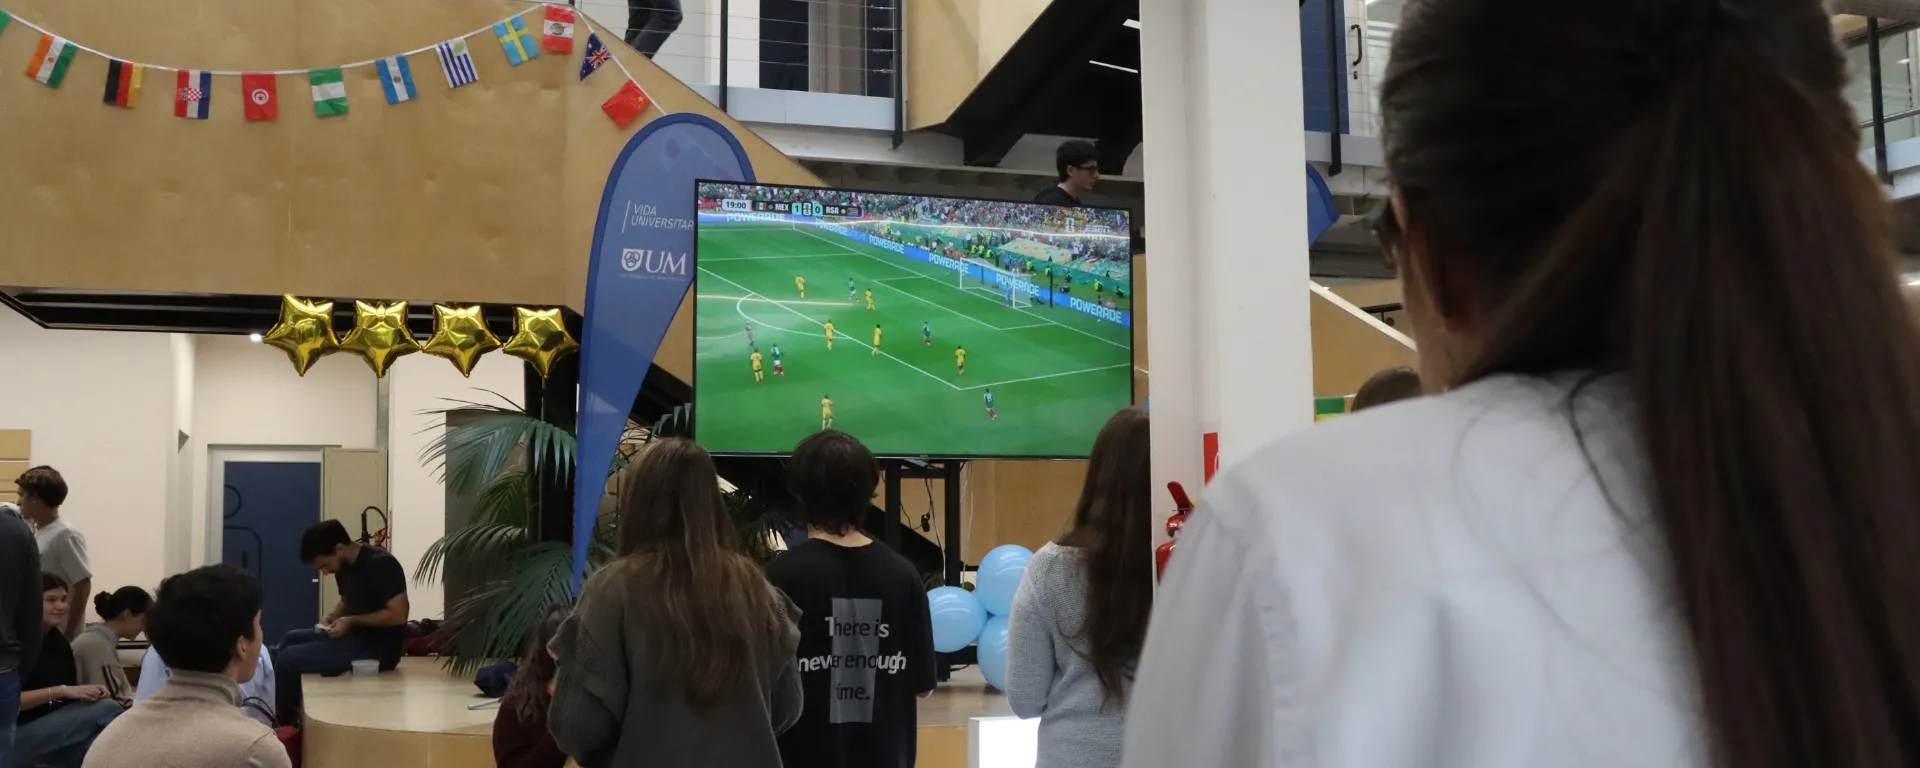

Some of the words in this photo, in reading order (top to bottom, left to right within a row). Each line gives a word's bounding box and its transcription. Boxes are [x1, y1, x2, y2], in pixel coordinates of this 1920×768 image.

[634, 203, 657, 216] VIDA
[726, 201, 747, 210] 19:00
[775, 203, 789, 212] MEX
[795, 204, 799, 212] 1
[815, 205, 821, 214] 0
[826, 206, 839, 214] RSA
[726, 211, 785, 223] POWERADE
[631, 215, 694, 230] UNIVERSITAR
[868, 235, 905, 254] POWERADE
[645, 249, 687, 275] UM
[928, 252, 969, 273] POWERADE
[996, 272, 1040, 296] POWERADE
[1069, 297, 1122, 323] POWERADE
[824, 616, 871, 637] There
[874, 618, 890, 638] is
[798, 654, 843, 672] never
[844, 651, 907, 674] enough
